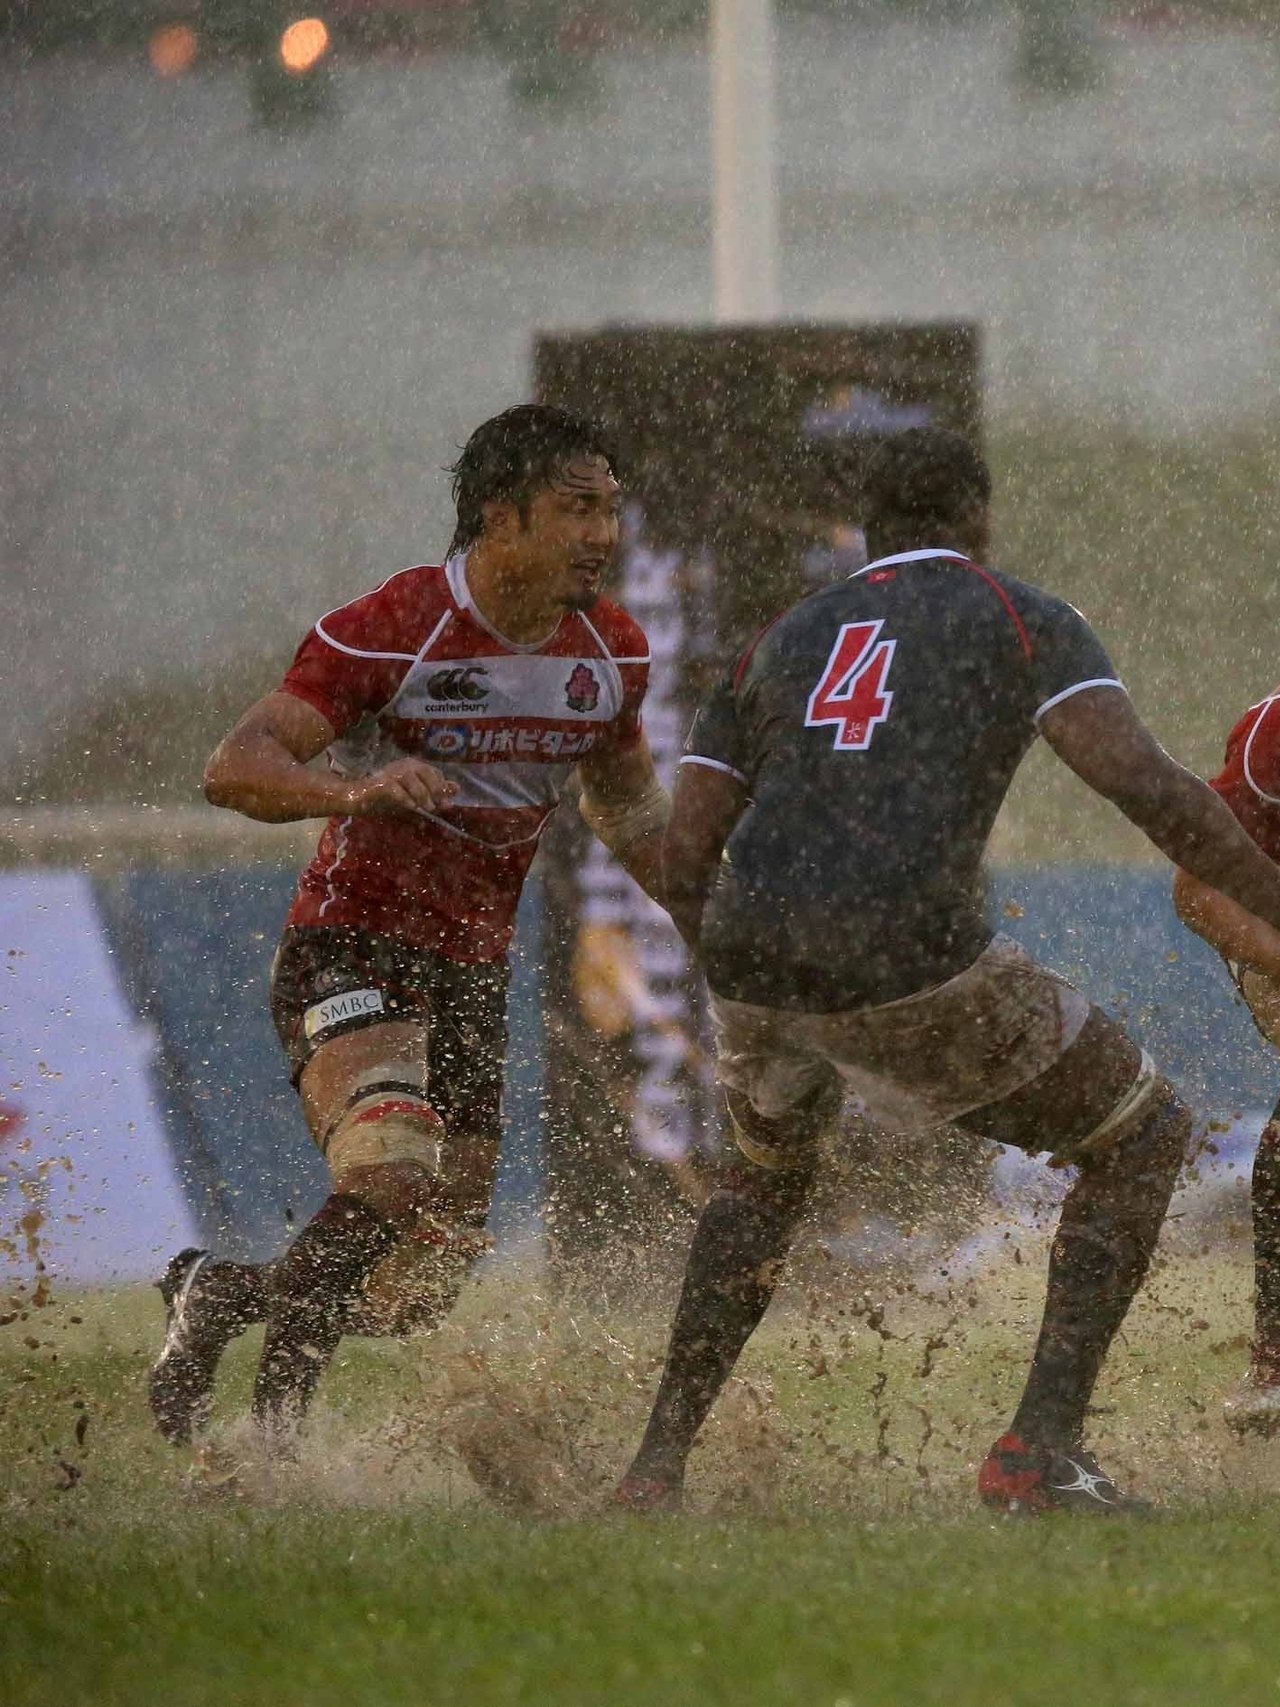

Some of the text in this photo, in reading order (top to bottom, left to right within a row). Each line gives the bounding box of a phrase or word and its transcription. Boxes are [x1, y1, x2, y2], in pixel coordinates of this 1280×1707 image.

[804, 618, 898, 751] 4
[425, 701, 490, 714] canterbury
[320, 993, 380, 1024] SMBC
